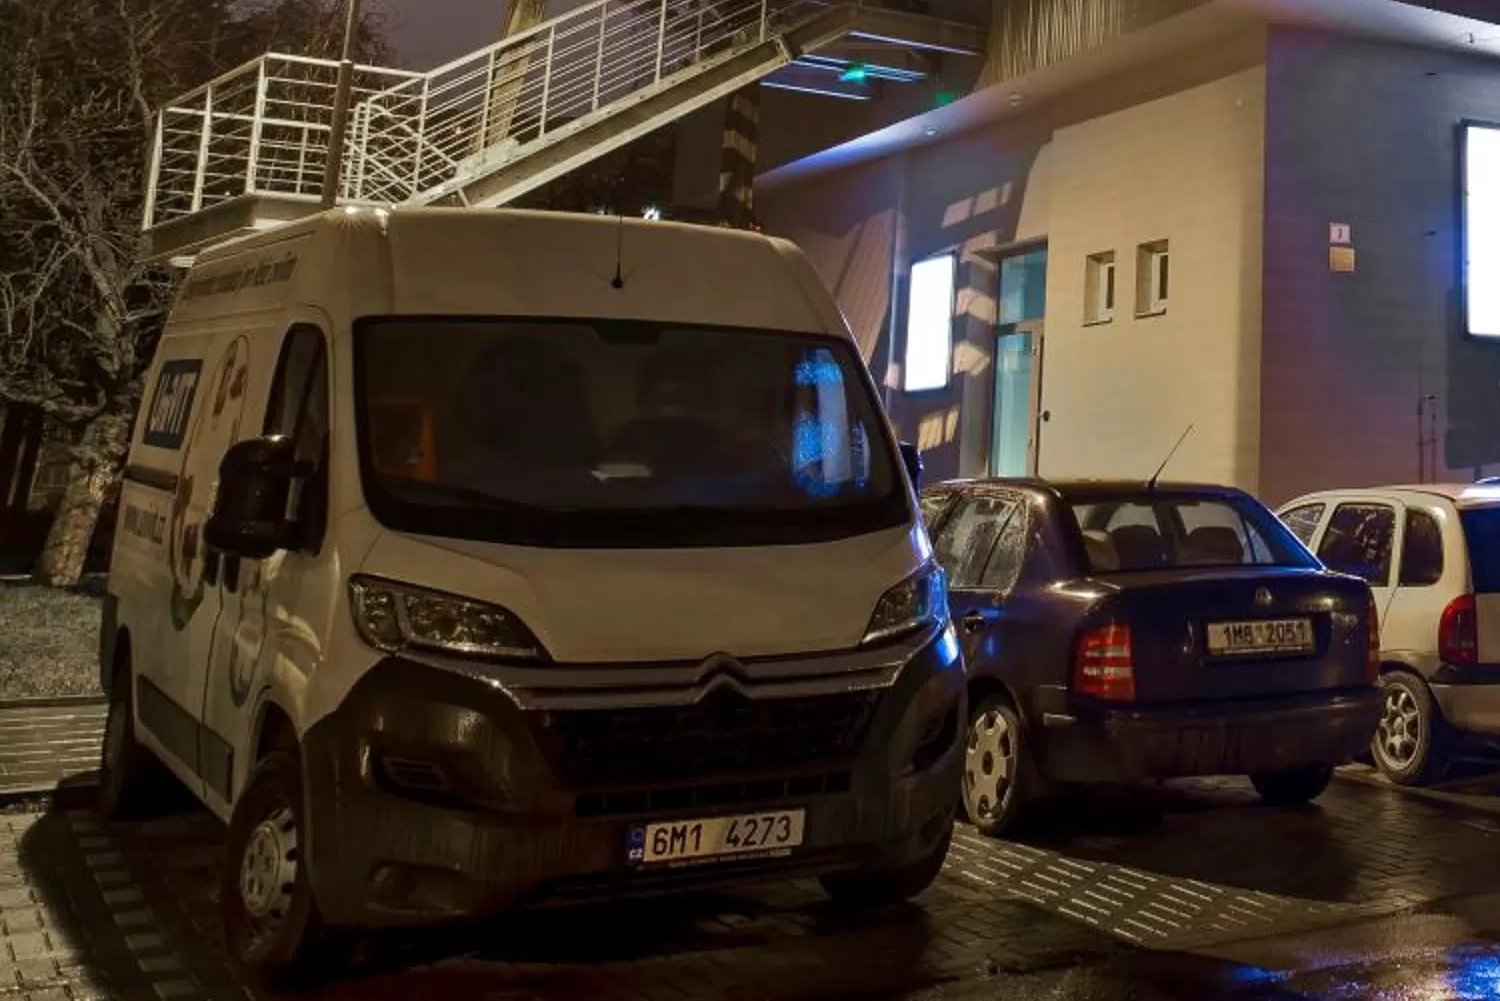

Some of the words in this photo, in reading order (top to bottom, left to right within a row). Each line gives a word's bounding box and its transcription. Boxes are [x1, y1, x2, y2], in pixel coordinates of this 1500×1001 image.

[1266, 622, 1305, 644] 2051
[653, 824, 702, 855] 6M1
[726, 816, 791, 848] 4273
